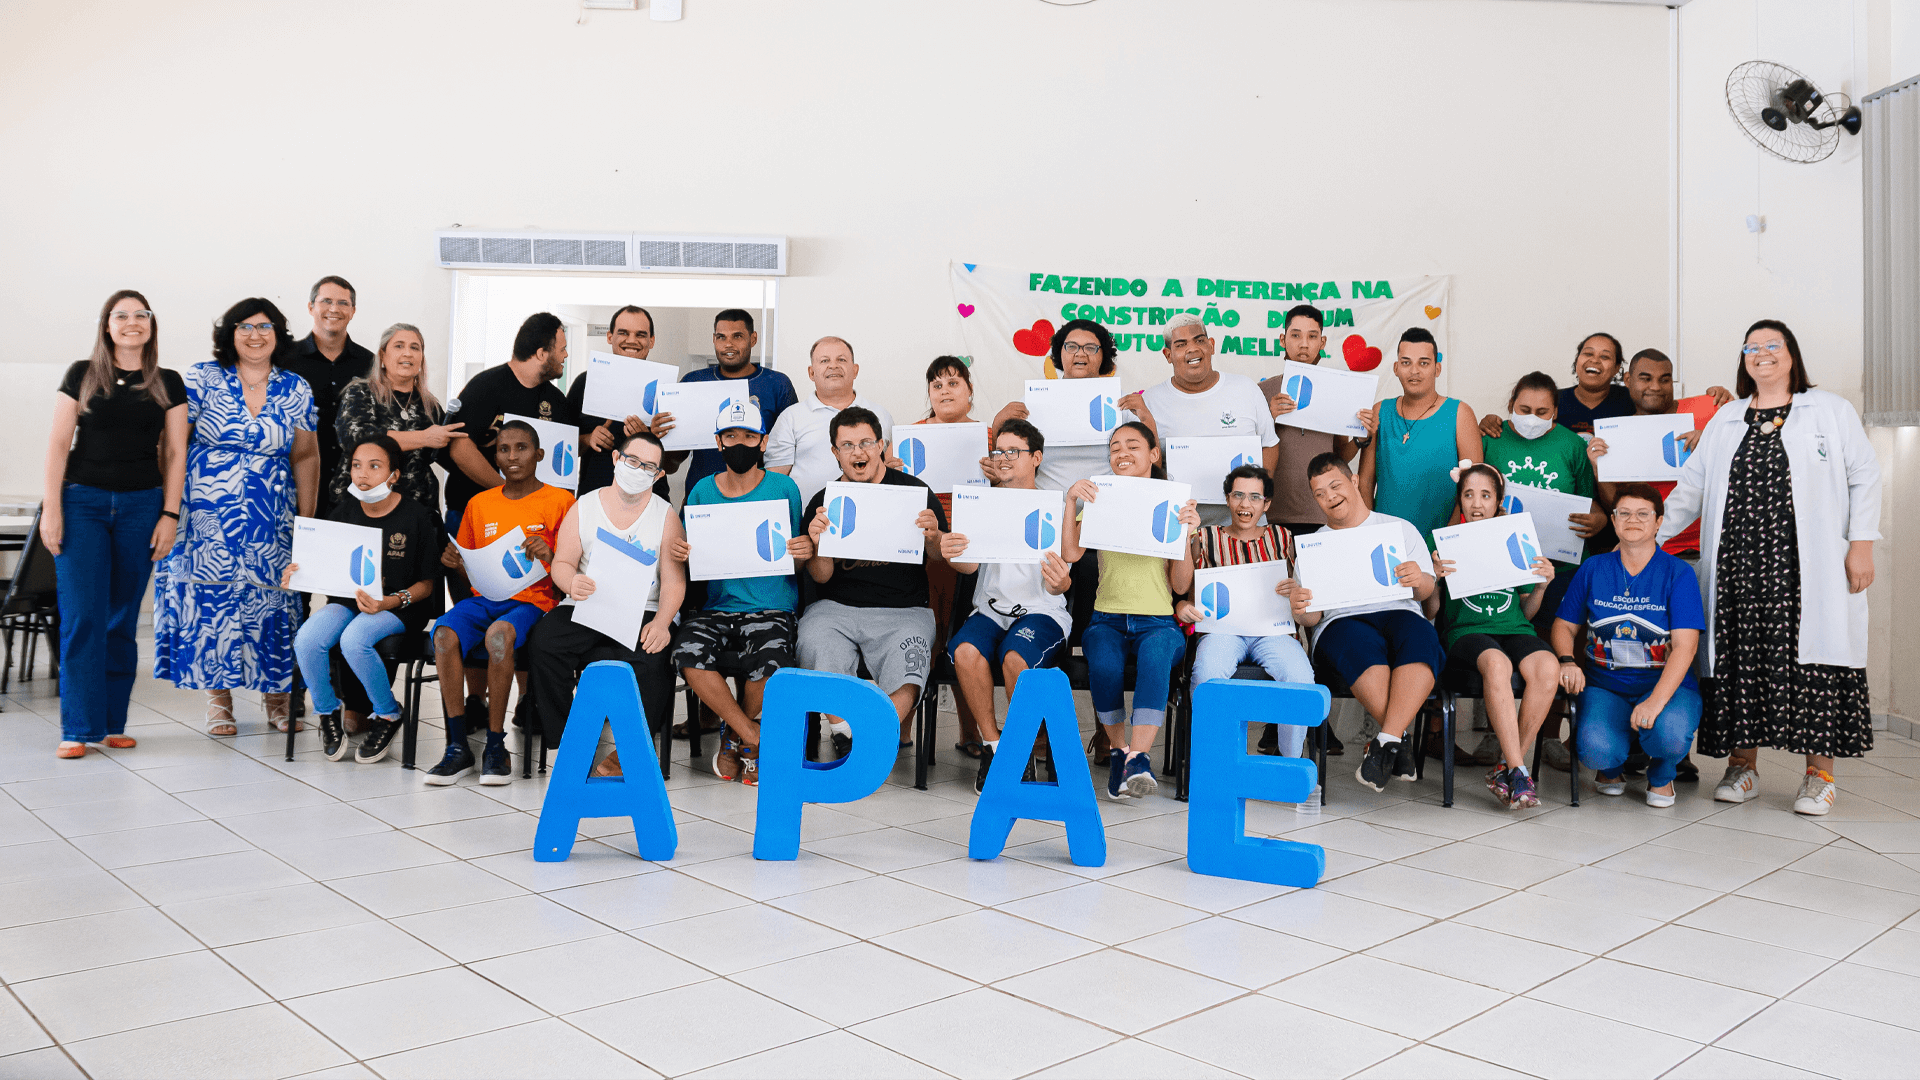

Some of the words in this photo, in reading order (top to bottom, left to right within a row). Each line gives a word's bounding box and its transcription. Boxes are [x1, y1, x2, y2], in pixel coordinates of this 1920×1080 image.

[1029, 272, 1148, 297] FAZENDO
[1161, 278, 1184, 298] A
[1196, 277, 1342, 304] DIFERENÇA
[1352, 280, 1394, 299] NA
[1322, 307, 1355, 327] UM
[1108, 333, 1166, 352] UTU
[386, 550, 406, 558] APAE
[1594, 599, 1632, 612] EDUCAÇÃO
[1633, 603, 1667, 612] ESPECIAL
[1612, 595, 1639, 604] ESCOLA
[533, 659, 1331, 889] APAE
